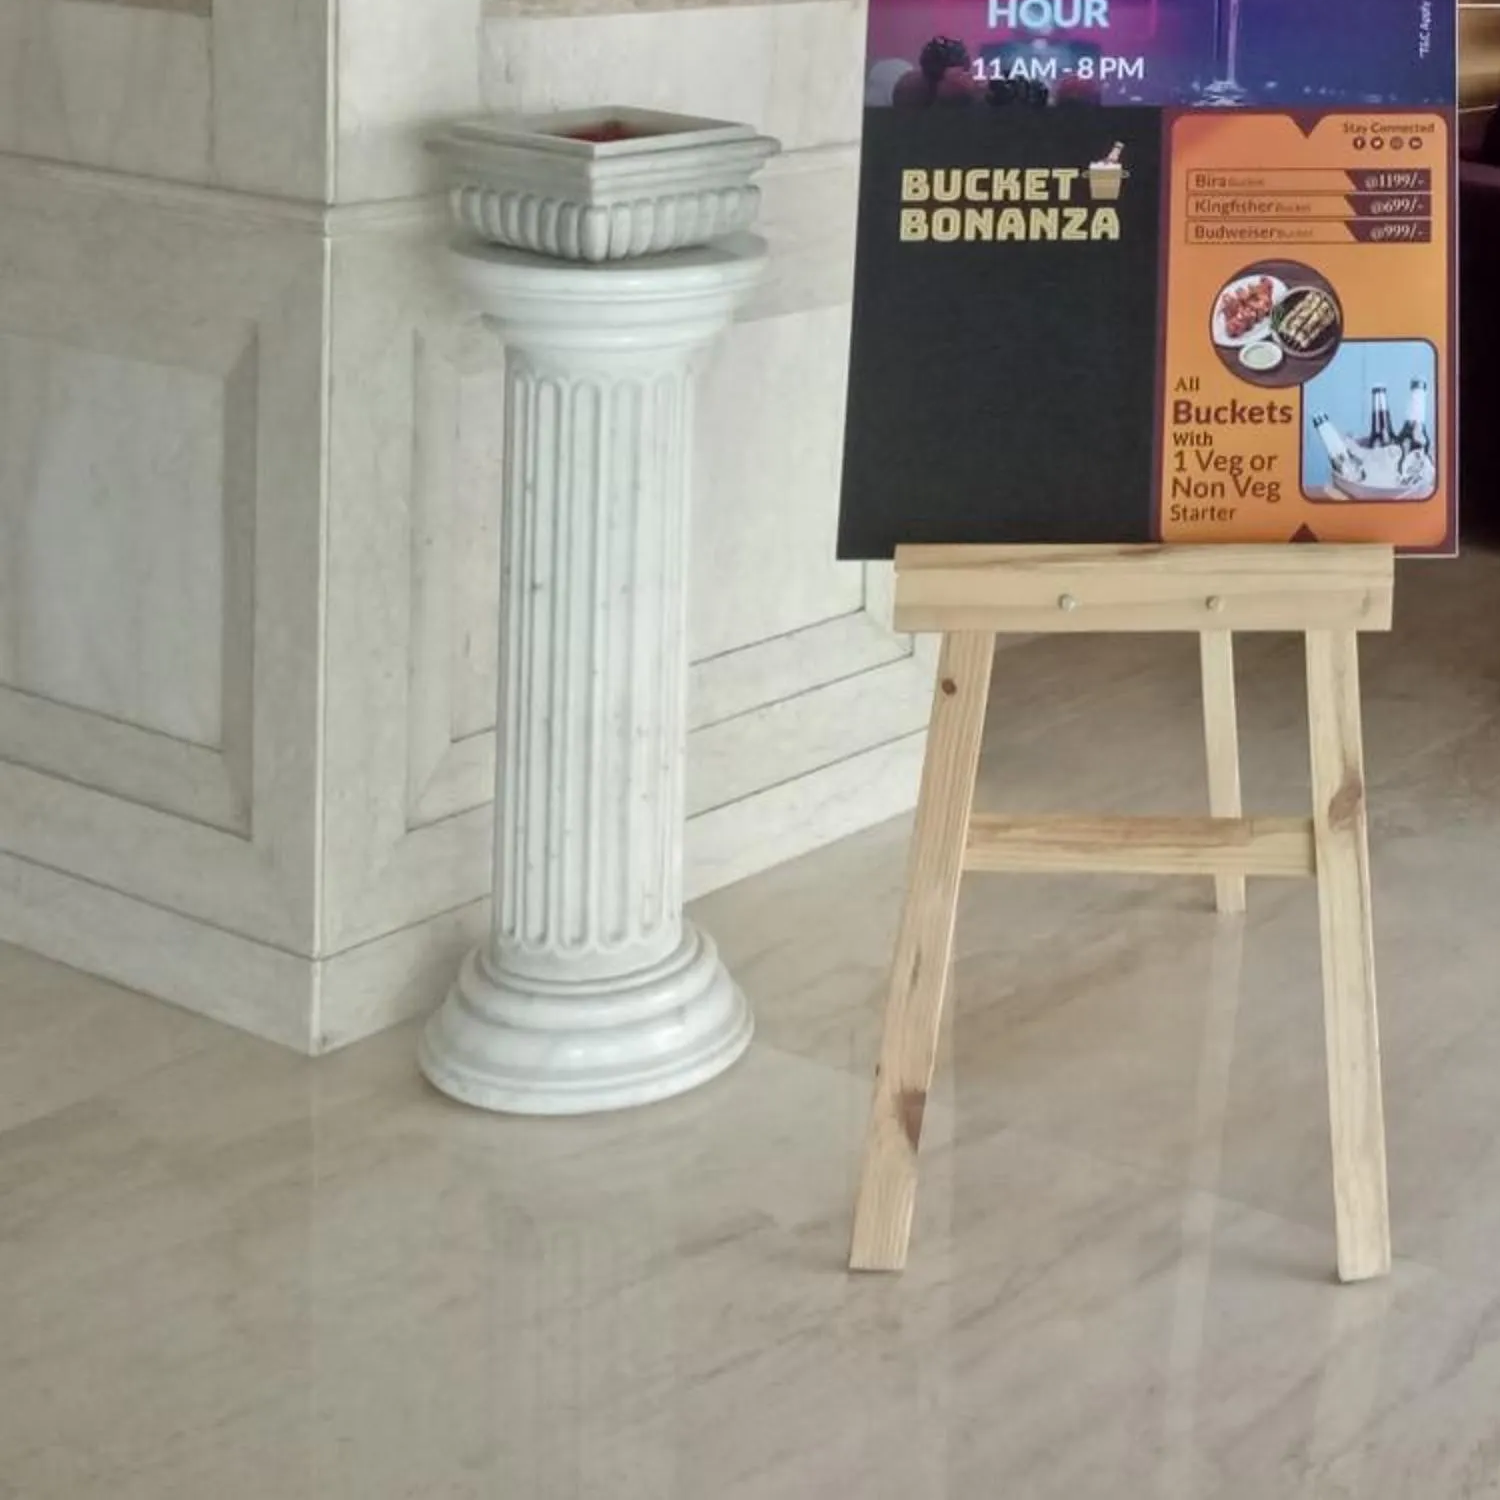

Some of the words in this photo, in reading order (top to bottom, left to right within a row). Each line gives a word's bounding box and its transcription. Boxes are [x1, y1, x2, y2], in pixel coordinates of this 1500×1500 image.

[971, 57, 1003, 80] 11
[1009, 57, 1059, 80] AM
[1077, 57, 1094, 80] 8
[1100, 57, 1145, 80] PM
[1343, 122, 1368, 136] Stay
[1370, 121, 1435, 134] Connected
[901, 168, 1079, 202] BUCKET
[1195, 174, 1227, 188] Bira
[1365, 173, 1424, 189] @1199/-
[1194, 198, 1274, 215] Kingfisher
[1370, 198, 1424, 214] @699/-
[899, 206, 1120, 241] BONANZA
[1194, 224, 1276, 240] Budweiser
[1370, 224, 1424, 240] @999/-
[1174, 376, 1200, 392] All
[1173, 400, 1293, 426] Buckets
[1172, 431, 1213, 447] With
[1174, 451, 1187, 472] 1
[1194, 450, 1245, 478] Veg
[1249, 456, 1278, 472] or
[1172, 477, 1226, 499] Non
[1231, 477, 1281, 503] Veg
[1170, 504, 1236, 522] Starter
